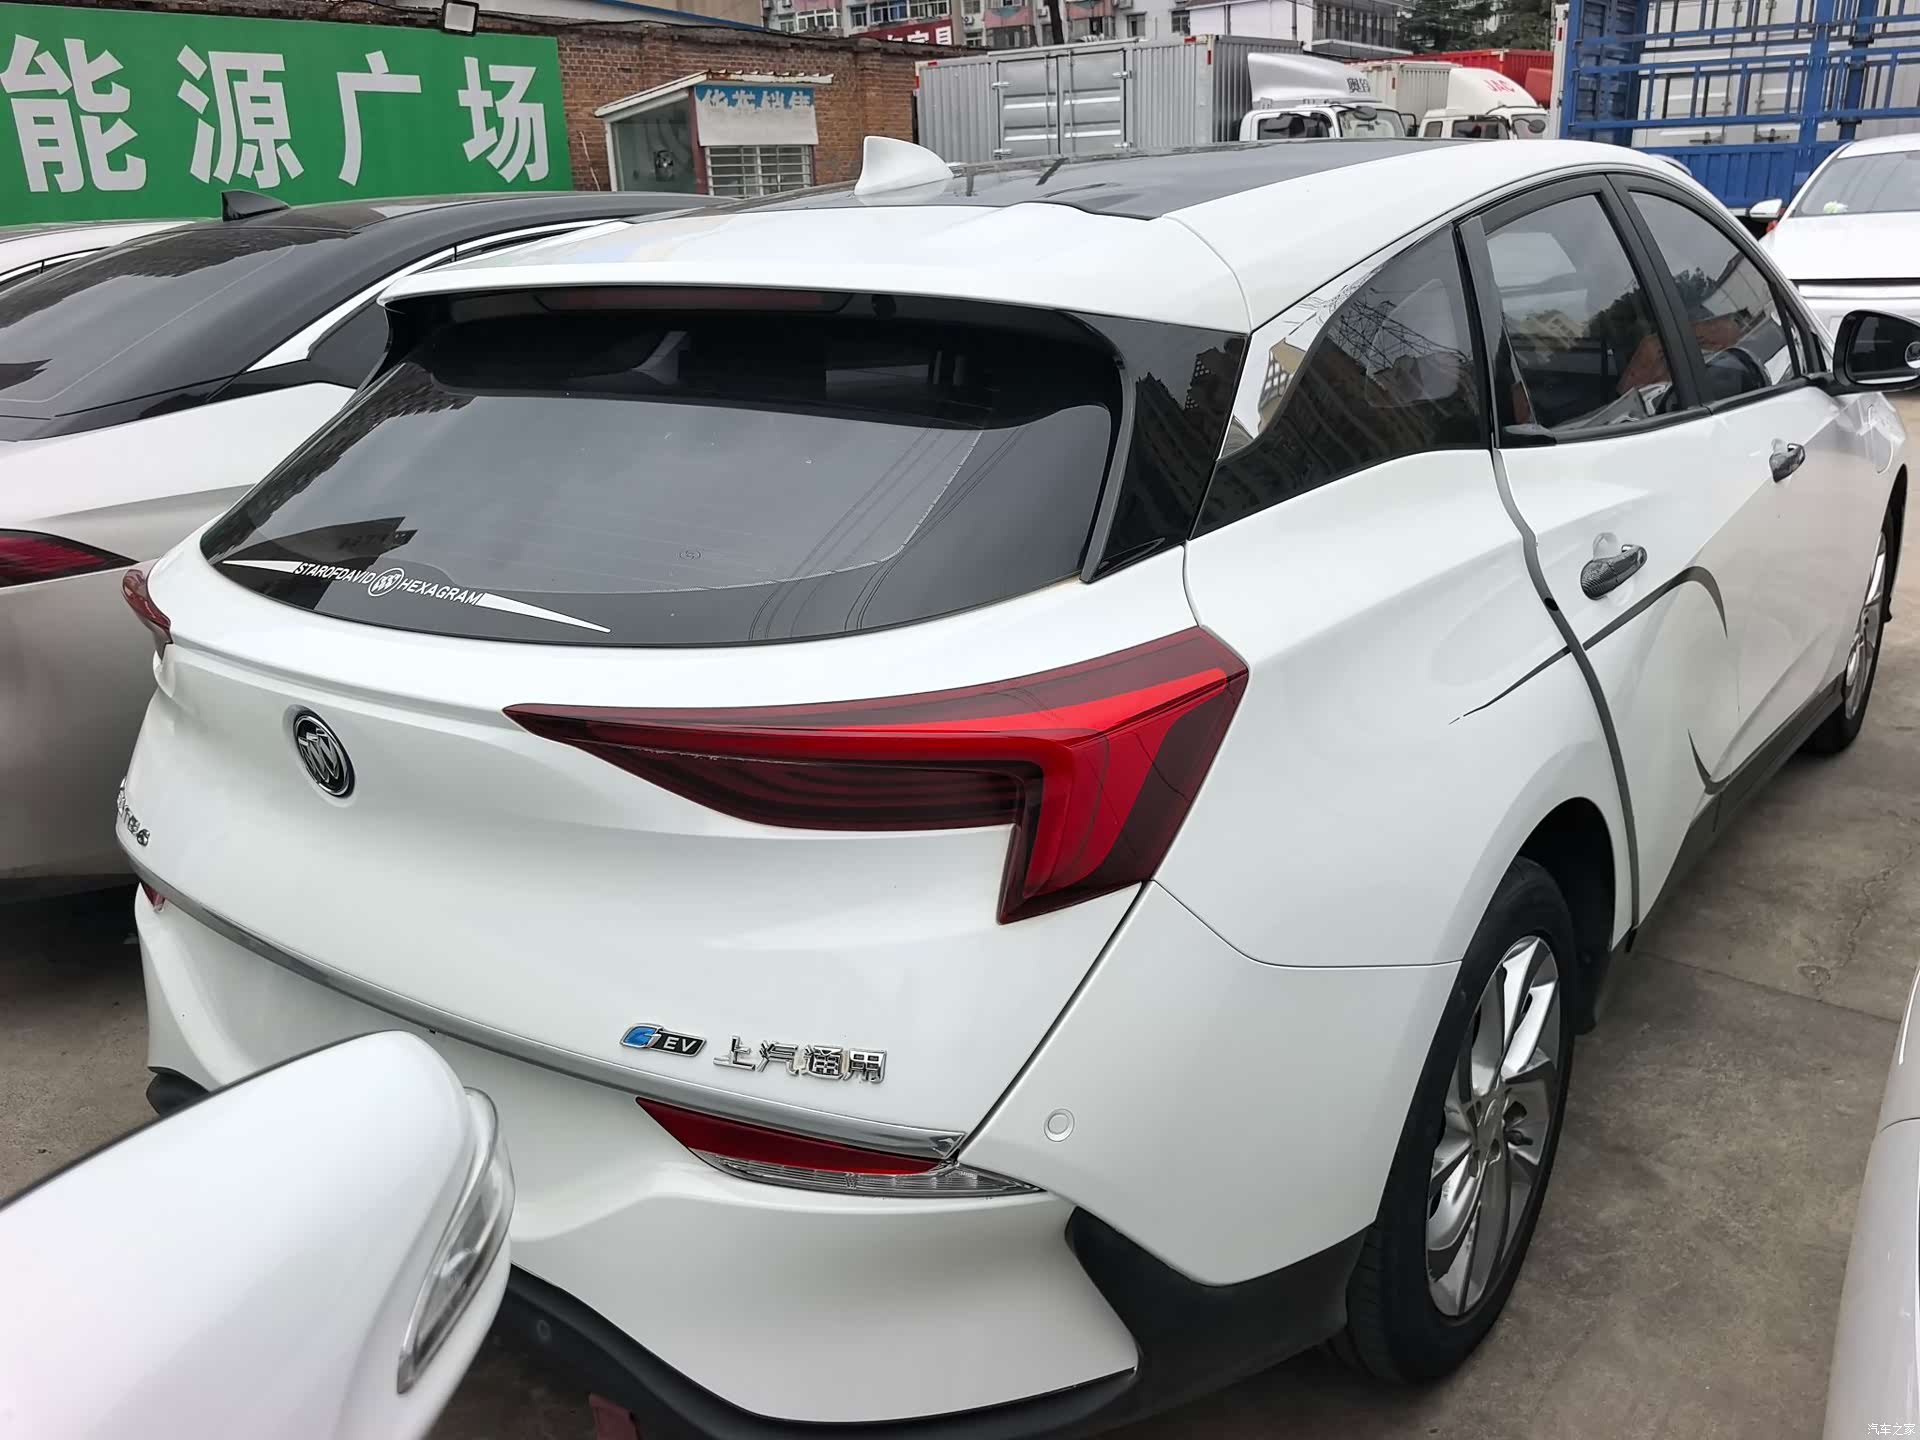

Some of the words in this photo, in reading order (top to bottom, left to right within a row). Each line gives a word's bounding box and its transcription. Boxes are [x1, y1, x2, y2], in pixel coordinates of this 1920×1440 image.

[0, 34, 549, 193] 能源广场
[295, 562, 376, 585] STAROFDAVID
[397, 578, 484, 605] HEXAGRAM
[713, 1035, 887, 1083] 上汽通用
